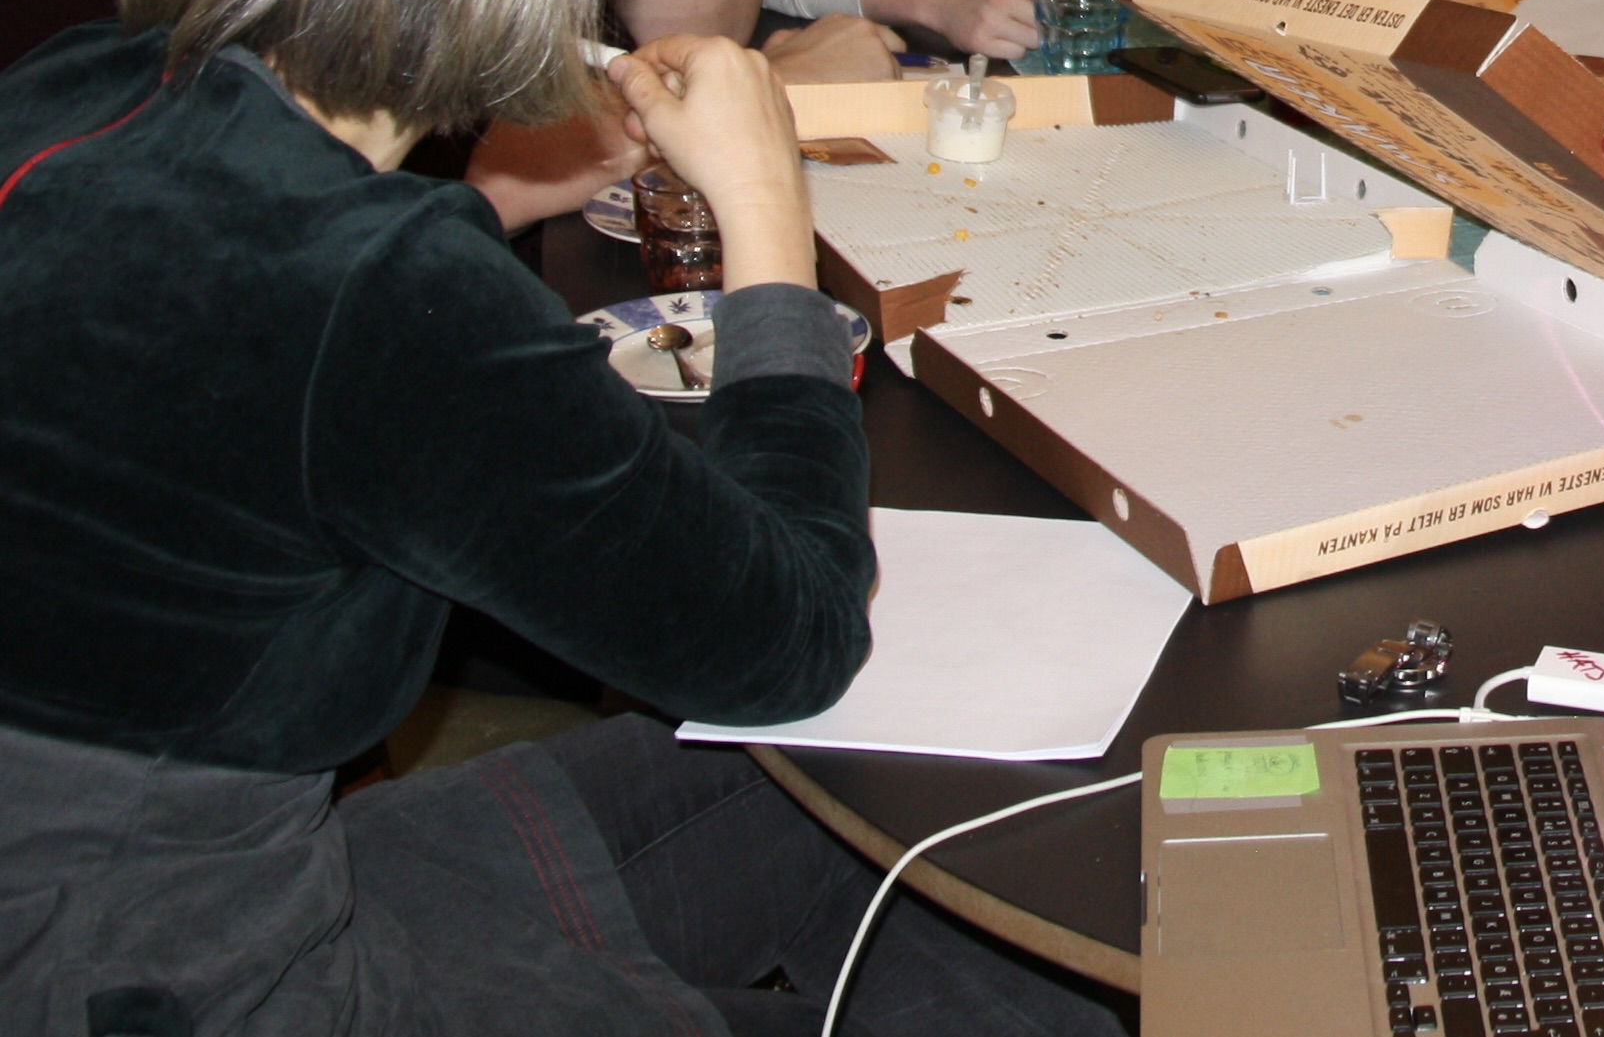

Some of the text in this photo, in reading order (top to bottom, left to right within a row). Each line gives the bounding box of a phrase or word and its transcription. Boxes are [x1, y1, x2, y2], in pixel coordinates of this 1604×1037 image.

[1338, 2, 1357, 20] DET
[1357, 6, 1374, 22] ER
[1373, 8, 1405, 29] OSTEN
[1507, 486, 1534, 507] HAR
[1539, 481, 1552, 499] VI
[1448, 504, 1466, 522] ER
[1471, 494, 1501, 515] SOM
[1407, 509, 1444, 533] HELT
[1317, 527, 1379, 556] KANTEN
[1384, 521, 1402, 544] PÅ
